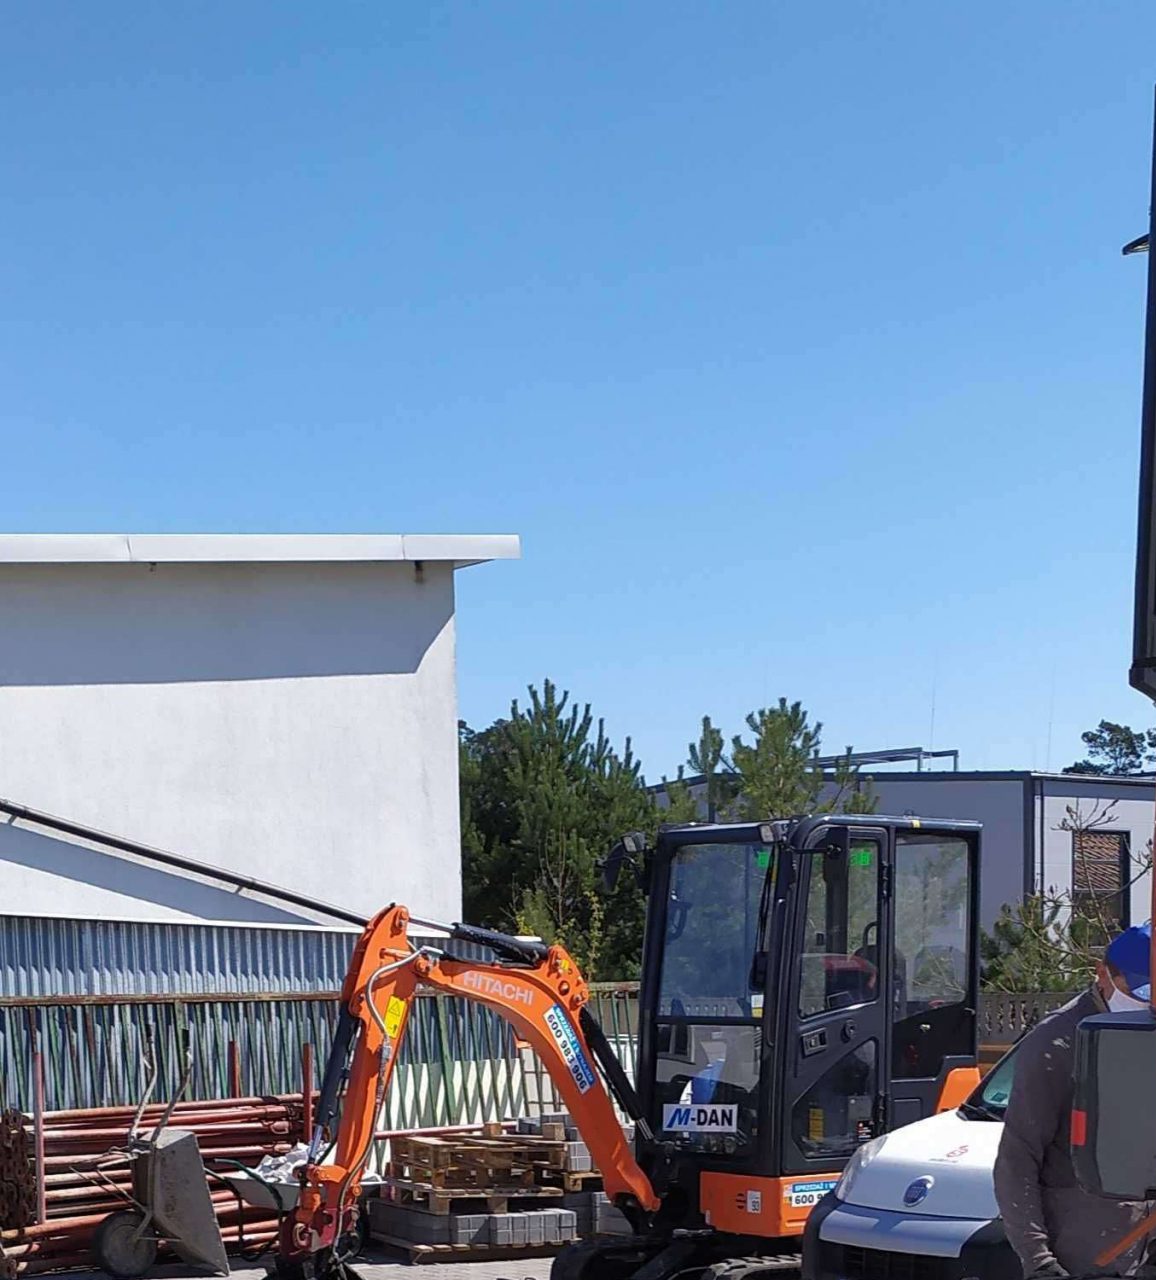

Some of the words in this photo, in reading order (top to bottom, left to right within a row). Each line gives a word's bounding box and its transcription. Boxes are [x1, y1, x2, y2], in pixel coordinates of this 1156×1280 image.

[463, 971, 534, 1006] HITACHI
[547, 1014, 562, 1038] 600
[560, 1040, 575, 1063] 983
[573, 1065, 588, 1088] 906
[666, 1108, 734, 1128] M-DAN
[794, 1195, 815, 1204] 600
